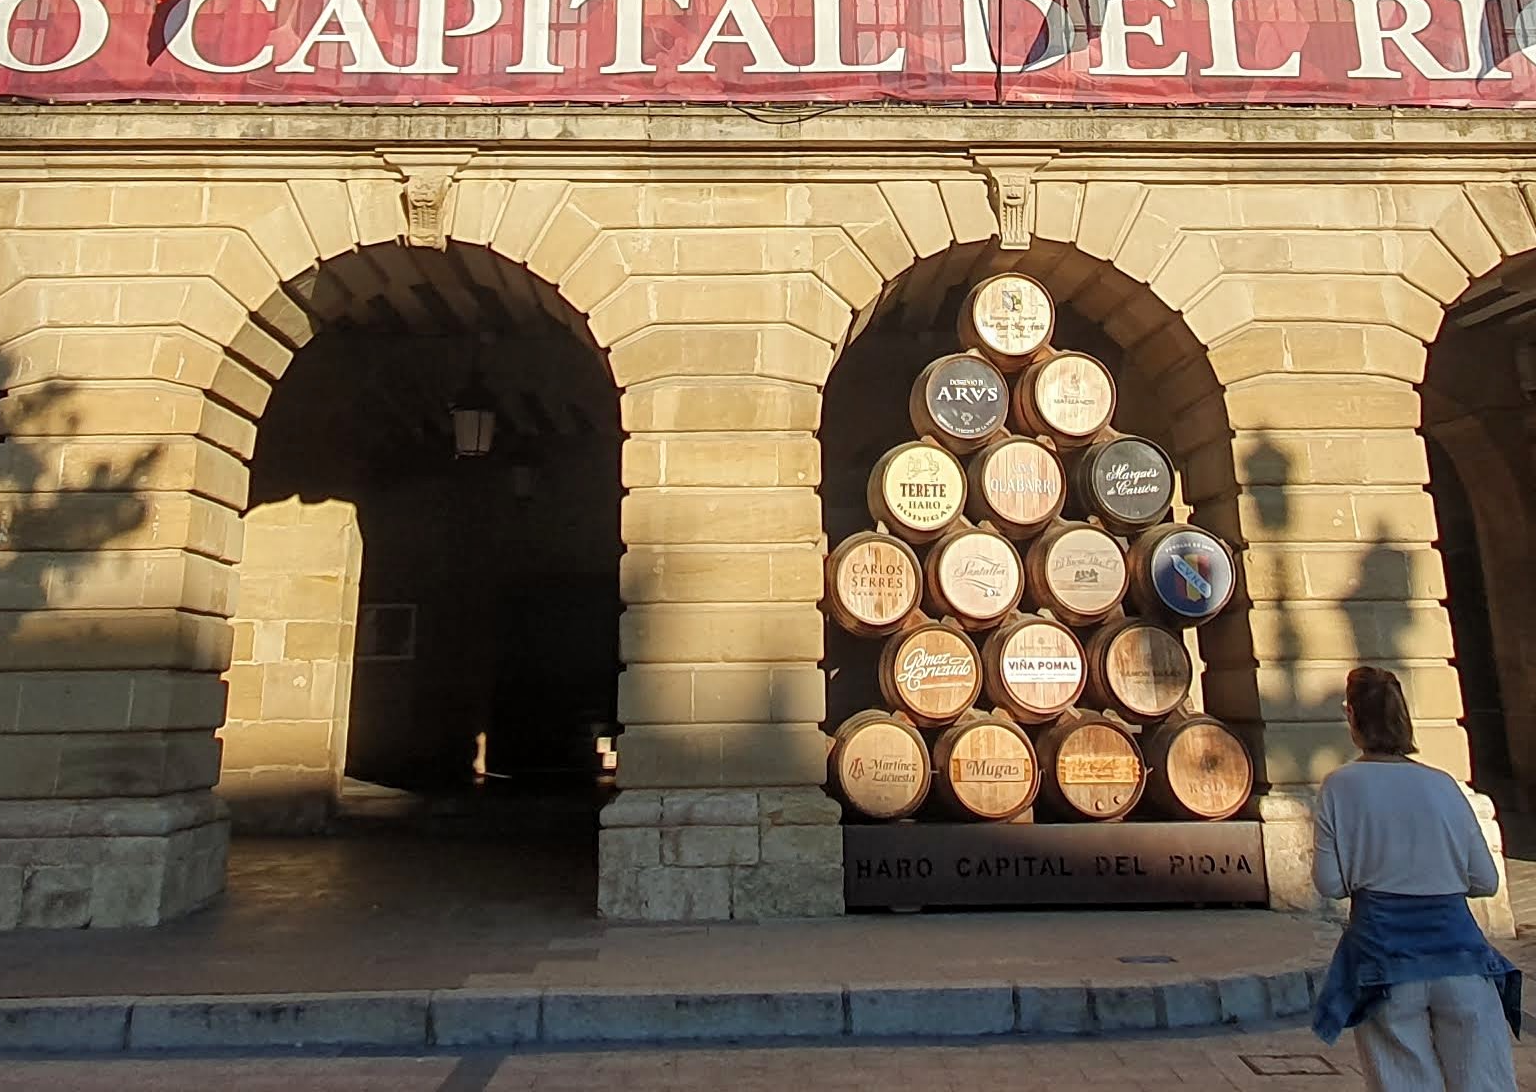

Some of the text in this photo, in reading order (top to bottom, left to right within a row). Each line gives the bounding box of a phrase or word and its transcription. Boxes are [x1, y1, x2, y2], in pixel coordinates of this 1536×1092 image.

[900, 483, 947, 498] TERETE
[908, 500, 941, 510] HARO
[852, 564, 902, 575] CARLOS
[851, 576, 902, 588] SERRES
[1008, 659, 1077, 670] VIÑA POMAL
[966, 760, 1019, 778] Muga
[855, 853, 1253, 879] HARO CAPITAL DEL RIOJA
